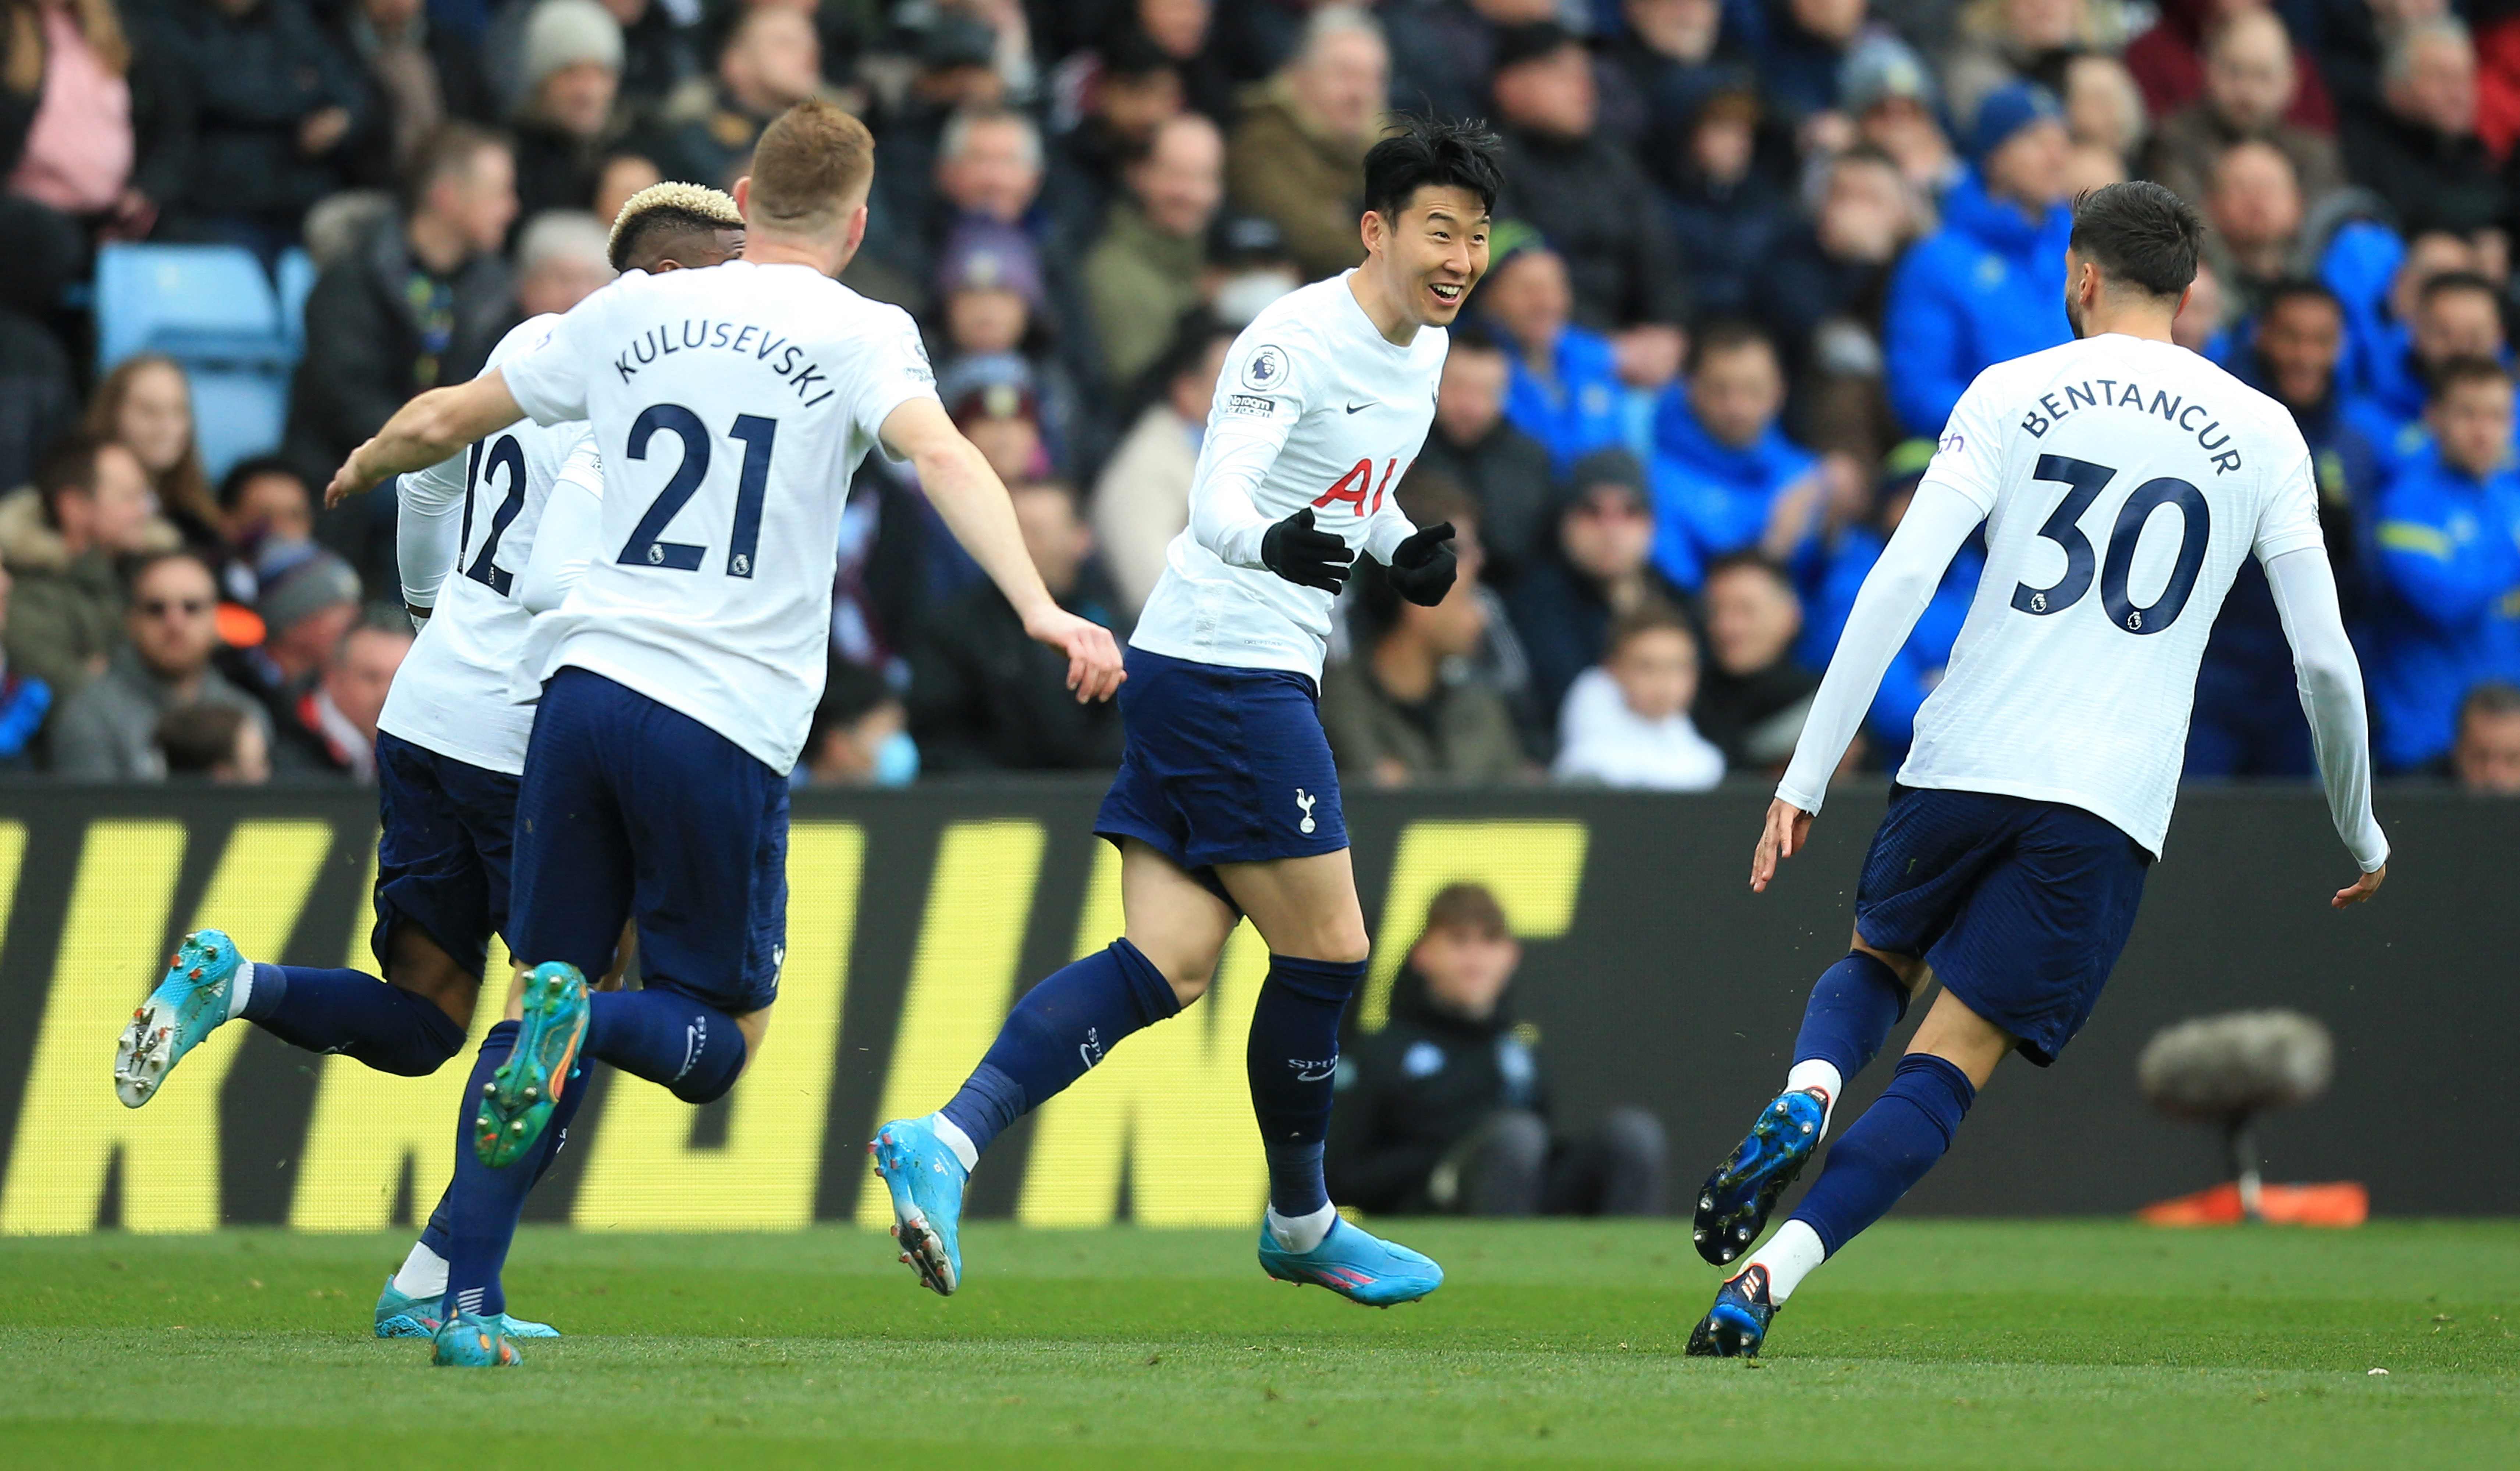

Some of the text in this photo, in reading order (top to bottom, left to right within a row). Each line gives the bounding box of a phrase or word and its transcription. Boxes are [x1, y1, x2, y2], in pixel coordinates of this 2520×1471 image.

[615, 319, 834, 407] KULUSEVSKI
[1241, 397, 1270, 410] room
[2021, 380, 2242, 476] BENTANCUR
[457, 434, 526, 598] 12
[616, 403, 777, 579] 21
[1310, 458, 1416, 517] AI
[2010, 453, 2211, 635] 30
